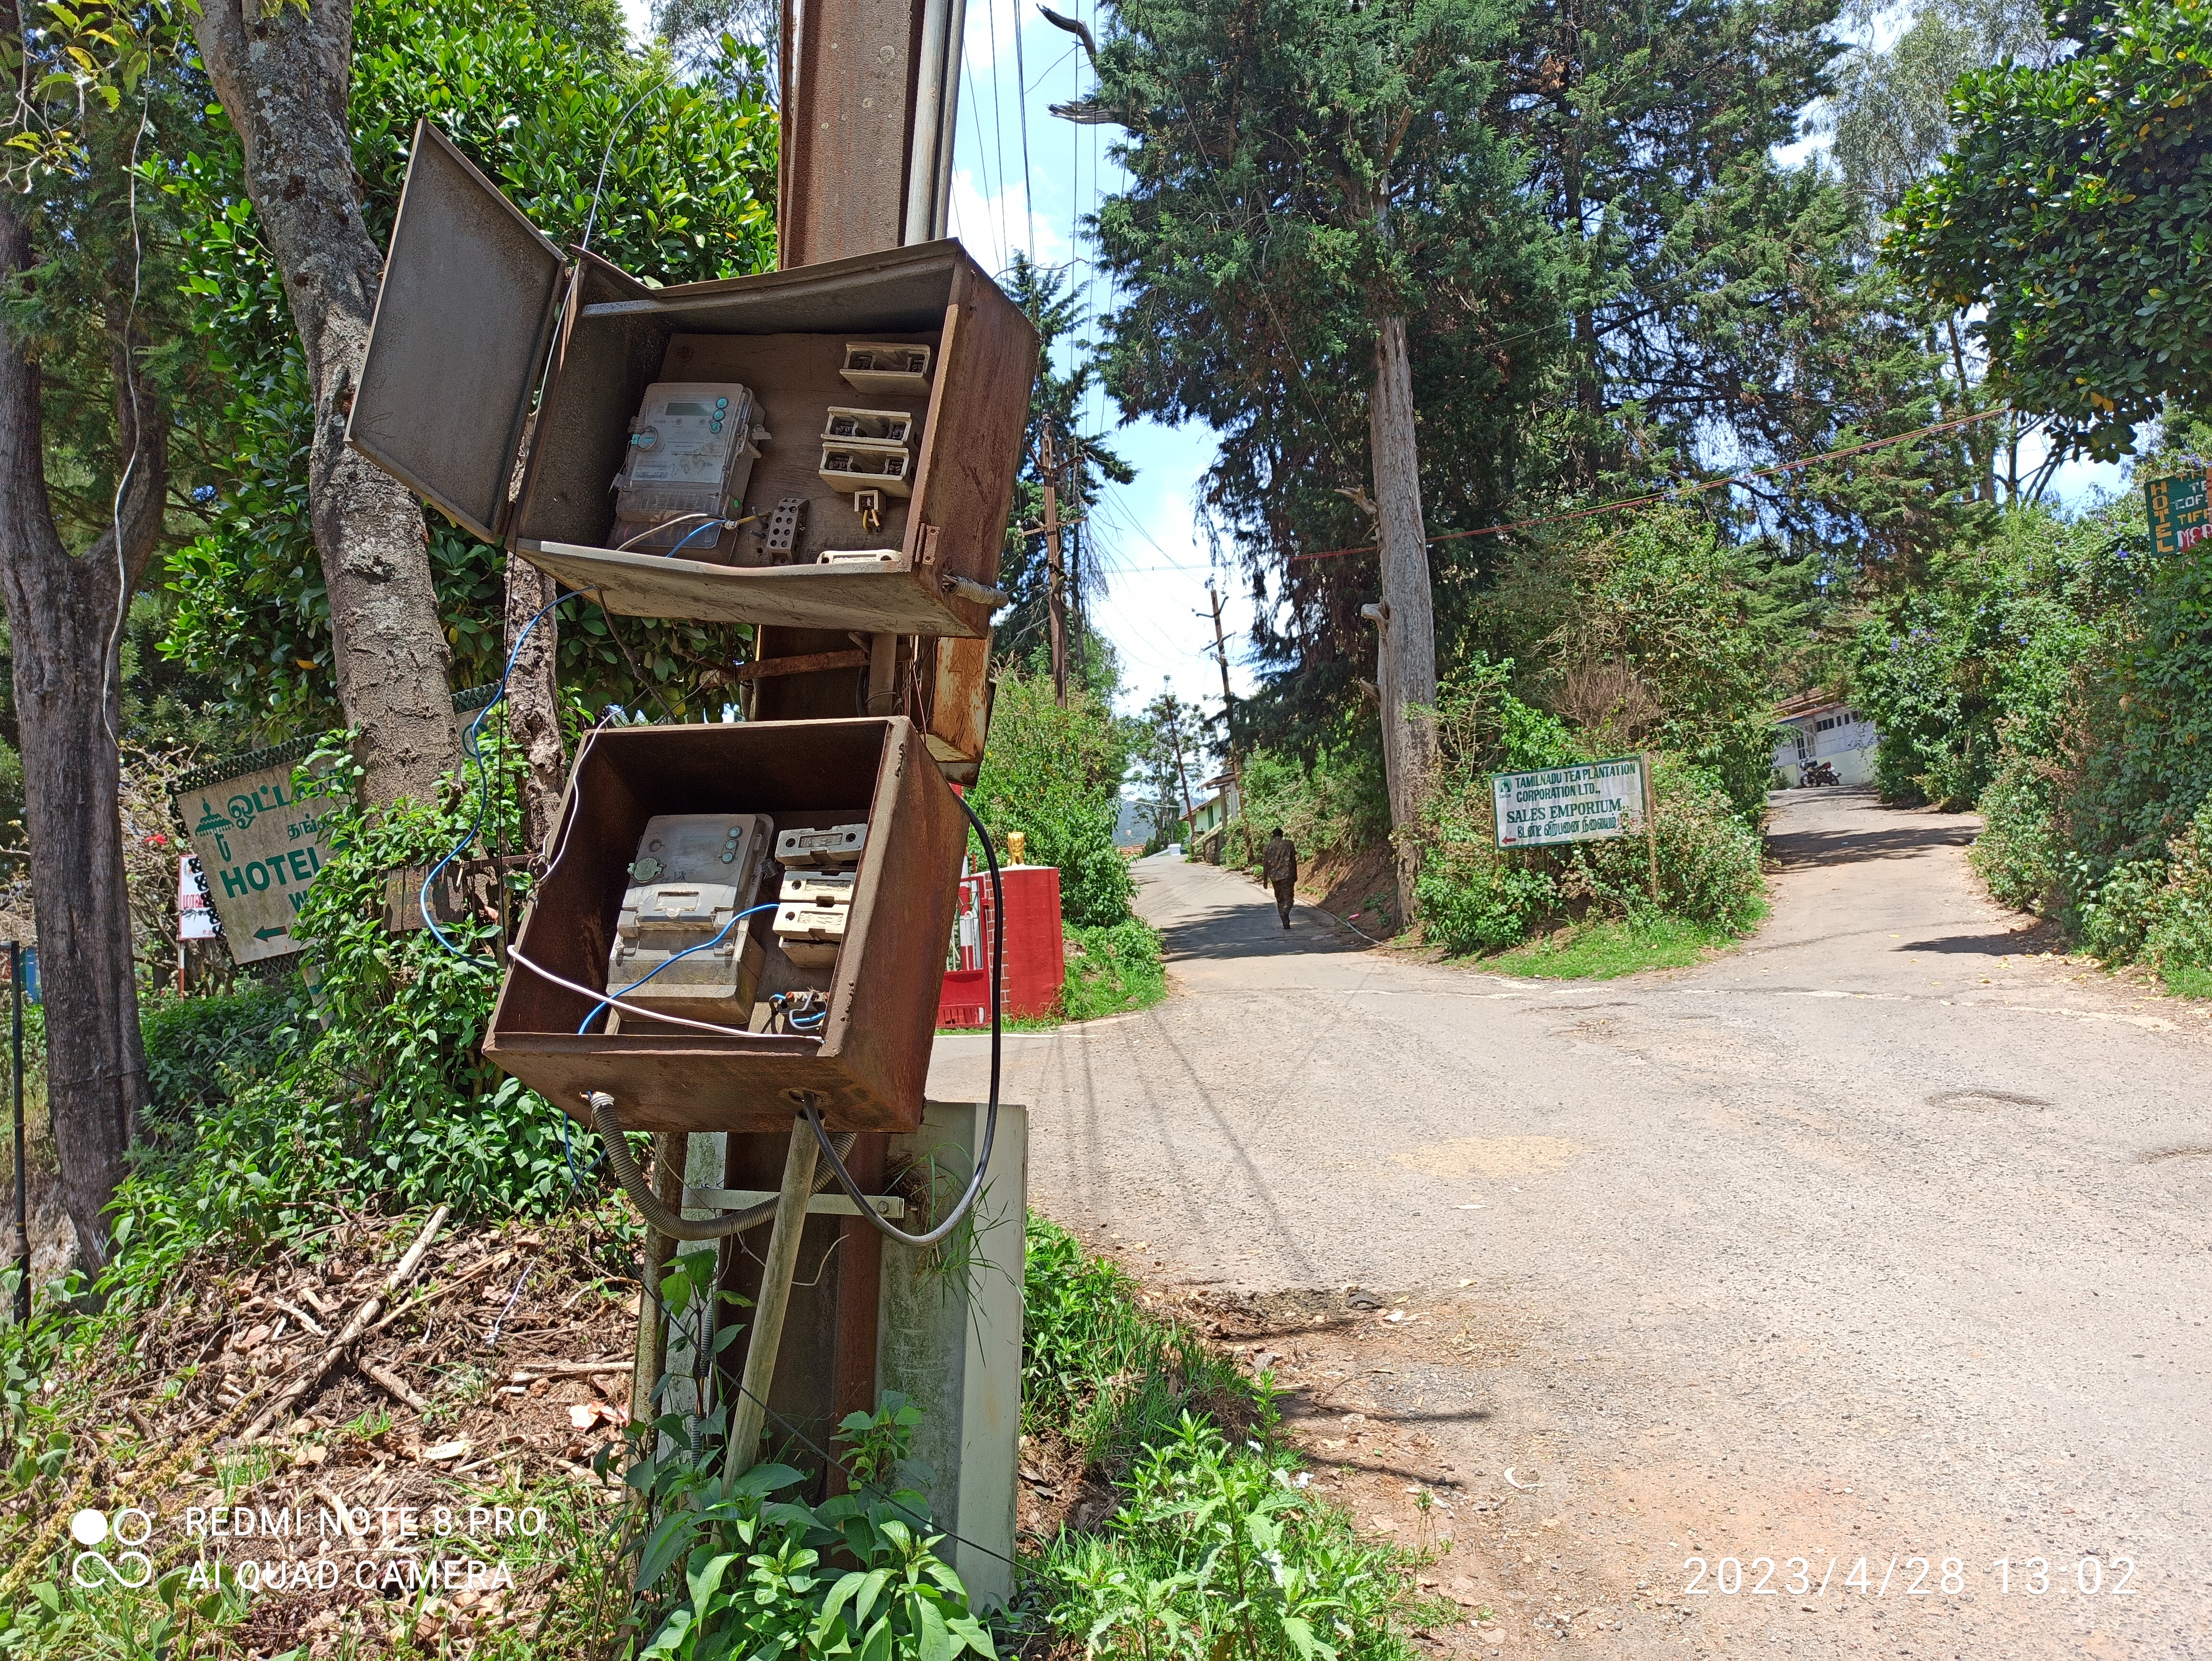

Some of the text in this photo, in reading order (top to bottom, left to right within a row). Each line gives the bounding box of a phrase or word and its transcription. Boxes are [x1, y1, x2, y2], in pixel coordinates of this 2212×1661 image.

[2150, 480, 2174, 554] HOTEL
[1515, 763, 1636, 788] TAMILNADU TEA PLANTATION
[1516, 786, 1576, 803] CORPORATION
[1507, 807, 1546, 824] SALES
[1544, 819, 1580, 838] விற்பனை
[1581, 813, 1616, 834] நிலையம்
[219, 846, 322, 899] HOTEL
